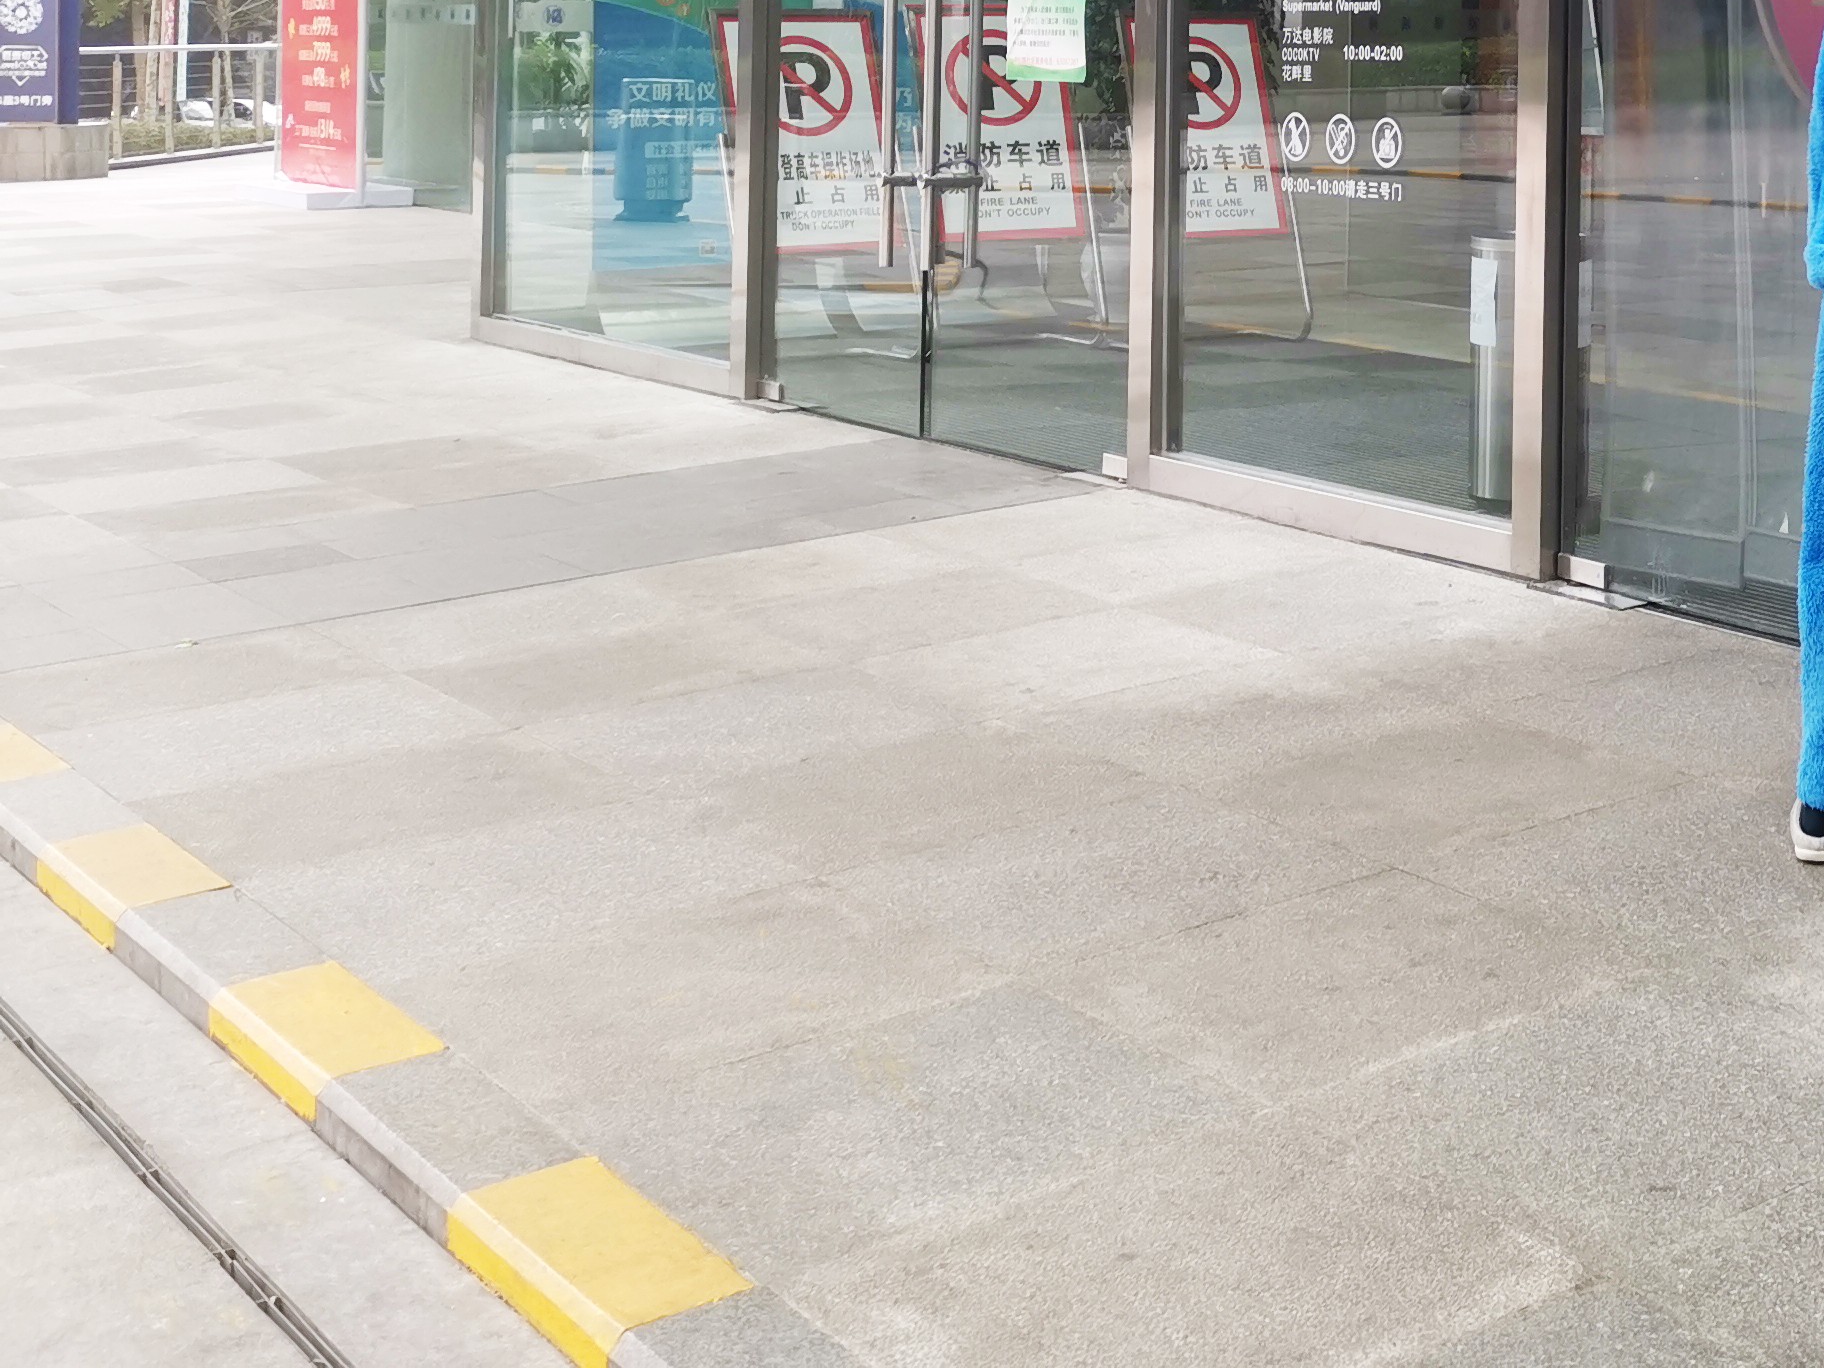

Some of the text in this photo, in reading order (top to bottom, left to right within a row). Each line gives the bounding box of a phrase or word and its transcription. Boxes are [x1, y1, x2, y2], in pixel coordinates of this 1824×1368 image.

[1282, 26, 1334, 45] 万达电影院
[1281, 44, 1403, 62] COCOKTV 10:00-02:00
[1281, 64, 1312, 82] 花畔里
[629, 82, 717, 103] 文明礼仪
[606, 107, 725, 129] 争做文明有
[779, 149, 881, 181] 登高车操作场地
[1186, 143, 1265, 171] 防车道
[1191, 175, 1269, 194] 止占用
[793, 183, 880, 205] 止占用
[979, 195, 1038, 207] FIRE LANE
[1189, 197, 1244, 209] FIRE LANE
[810, 208, 858, 219] OPERATION
[978, 206, 1051, 219] ON'T OCCUPY
[1186, 207, 1256, 220] ON'T OCCUPY
[820, 219, 855, 230] OCCUPY
